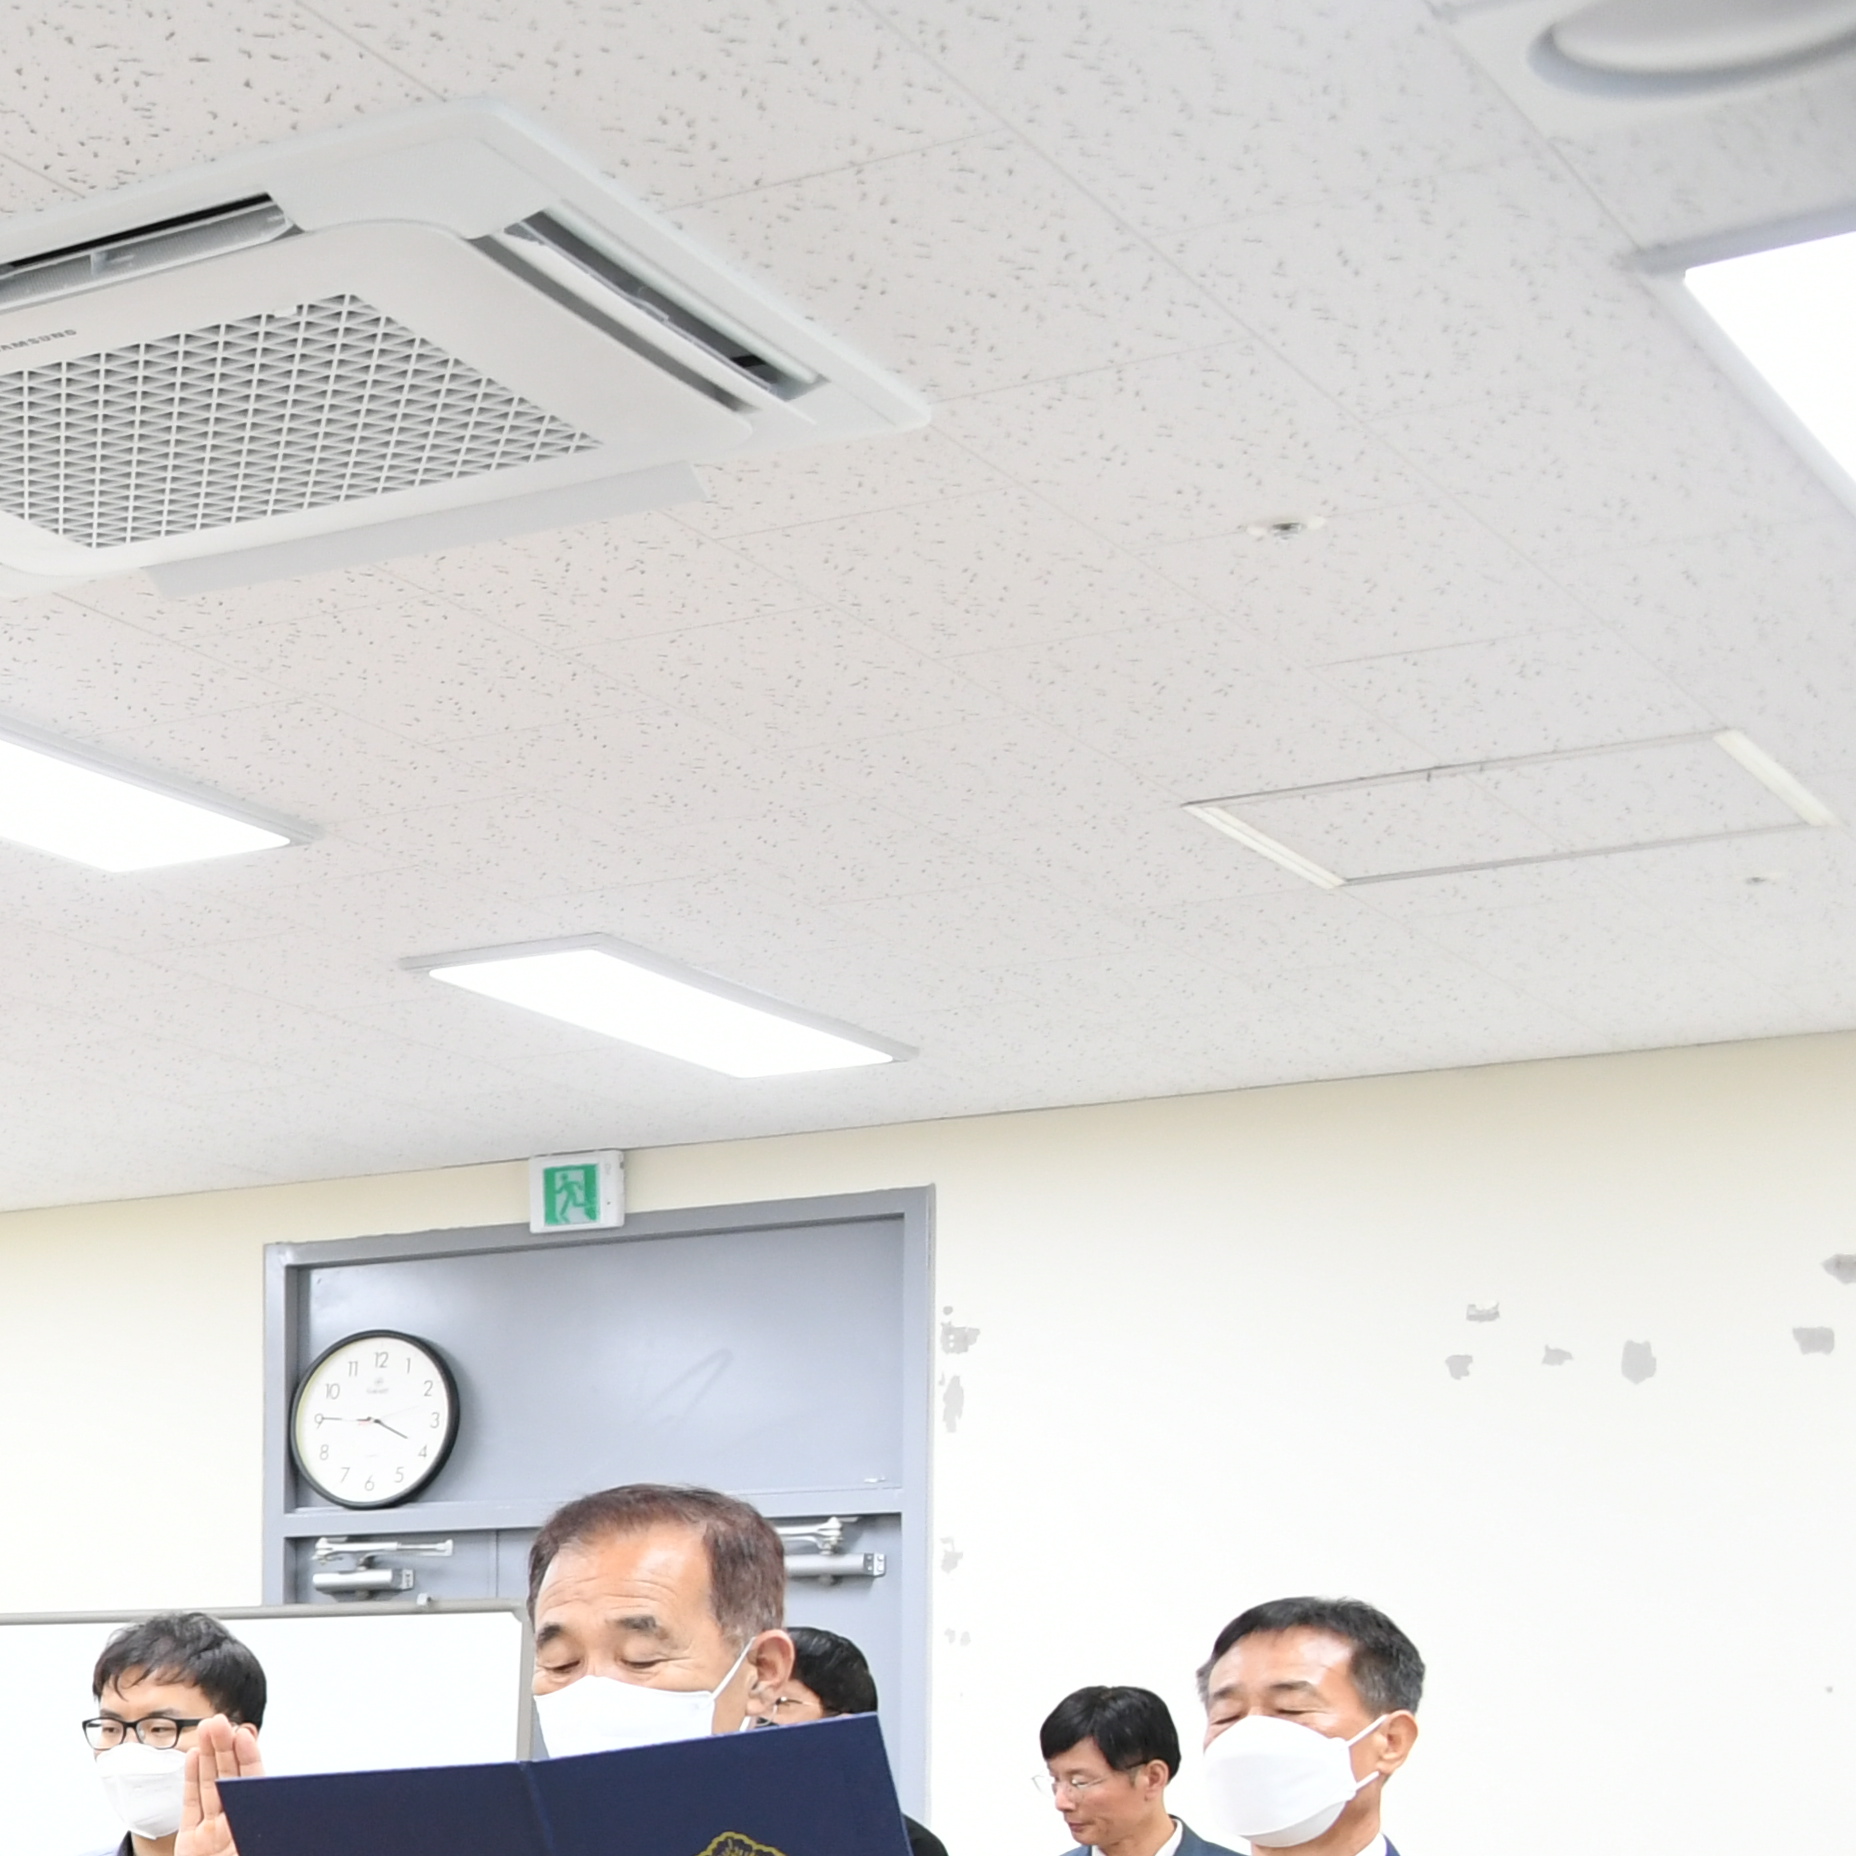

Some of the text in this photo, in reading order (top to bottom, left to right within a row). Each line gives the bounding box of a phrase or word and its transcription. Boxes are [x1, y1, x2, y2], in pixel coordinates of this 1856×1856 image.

[348, 1360, 359, 1377] 11
[374, 1351, 389, 1369] 12
[325, 1383, 341, 1400] 10
[423, 1380, 434, 1397] 2
[314, 1412, 324, 1429] 9
[430, 1411, 440, 1429] 3
[319, 1444, 329, 1460] 8
[417, 1444, 428, 1458] 4
[340, 1466, 351, 1484] 7
[364, 1474, 375, 1491] 6
[394, 1466, 404, 1483] 5
